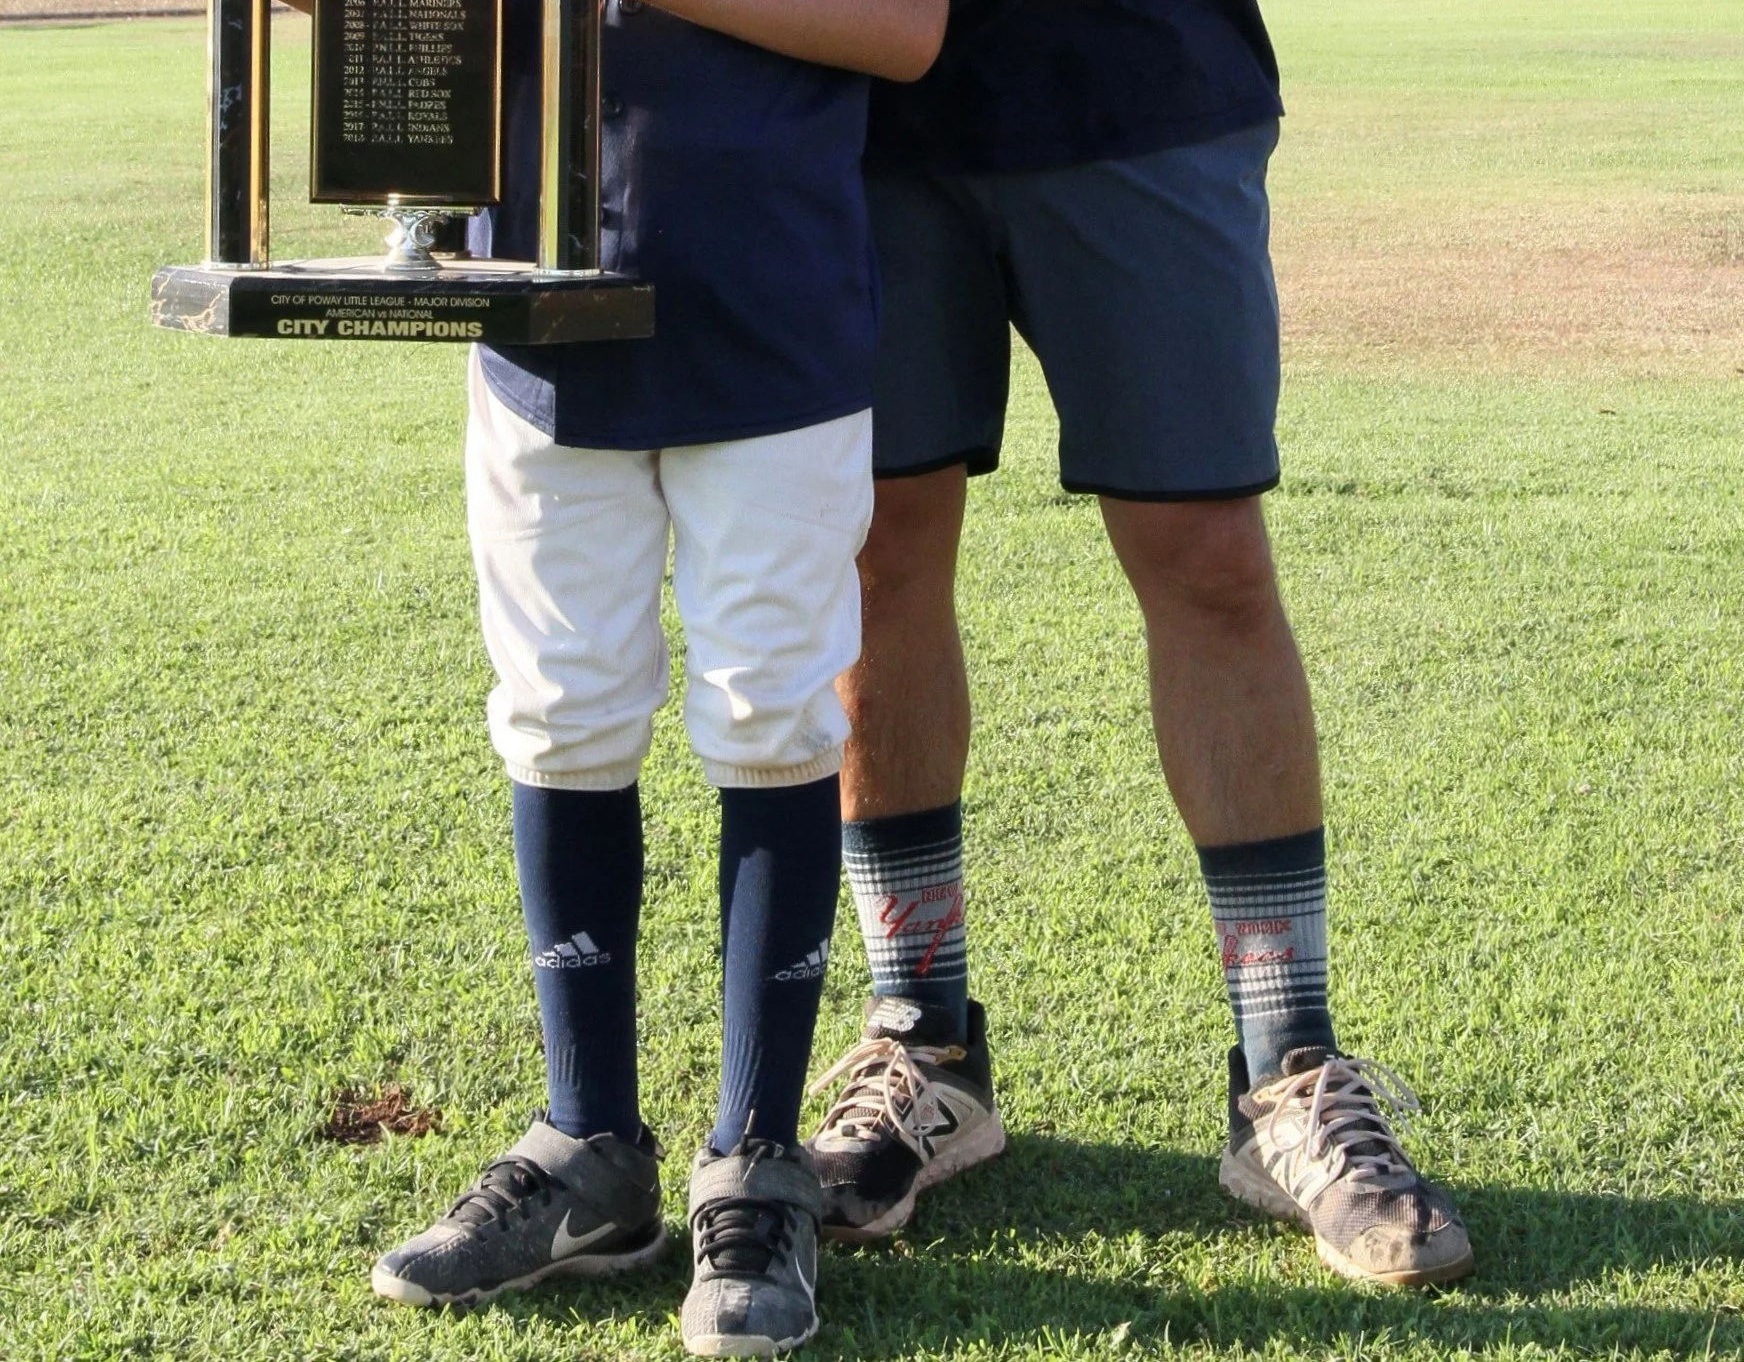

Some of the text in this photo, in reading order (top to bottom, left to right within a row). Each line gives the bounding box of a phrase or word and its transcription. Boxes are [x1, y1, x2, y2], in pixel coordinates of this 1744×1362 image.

[409, 9, 467, 19] NATIONALS
[409, 21, 441, 30] WHITE
[443, 21, 465, 31] SOX
[343, 54, 363, 64] 011
[343, 66, 365, 75] 2012
[408, 77, 436, 86] CUBS
[408, 89, 430, 98] RED
[431, 89, 453, 98] SOX
[408, 111, 449, 120] ROYALS
[343, 122, 364, 132] 2017
[408, 122, 451, 132] INDIANS
[407, 134, 454, 143] YANKEES
[271, 295, 291, 305] CITY
[293, 295, 306, 305] OF
[308, 295, 344, 306] POWAY
[344, 295, 367, 306] LITTLE
[370, 296, 405, 306] LEAGUE
[414, 297, 448, 307] MAJOR
[450, 297, 490, 307] DIVISION
[326, 308, 434, 319] AMERICAN vs NATIONAL
[277, 319, 483, 337] CITY CHAMPIONS
[534, 951, 612, 969] adidas
[775, 963, 827, 981] adid
